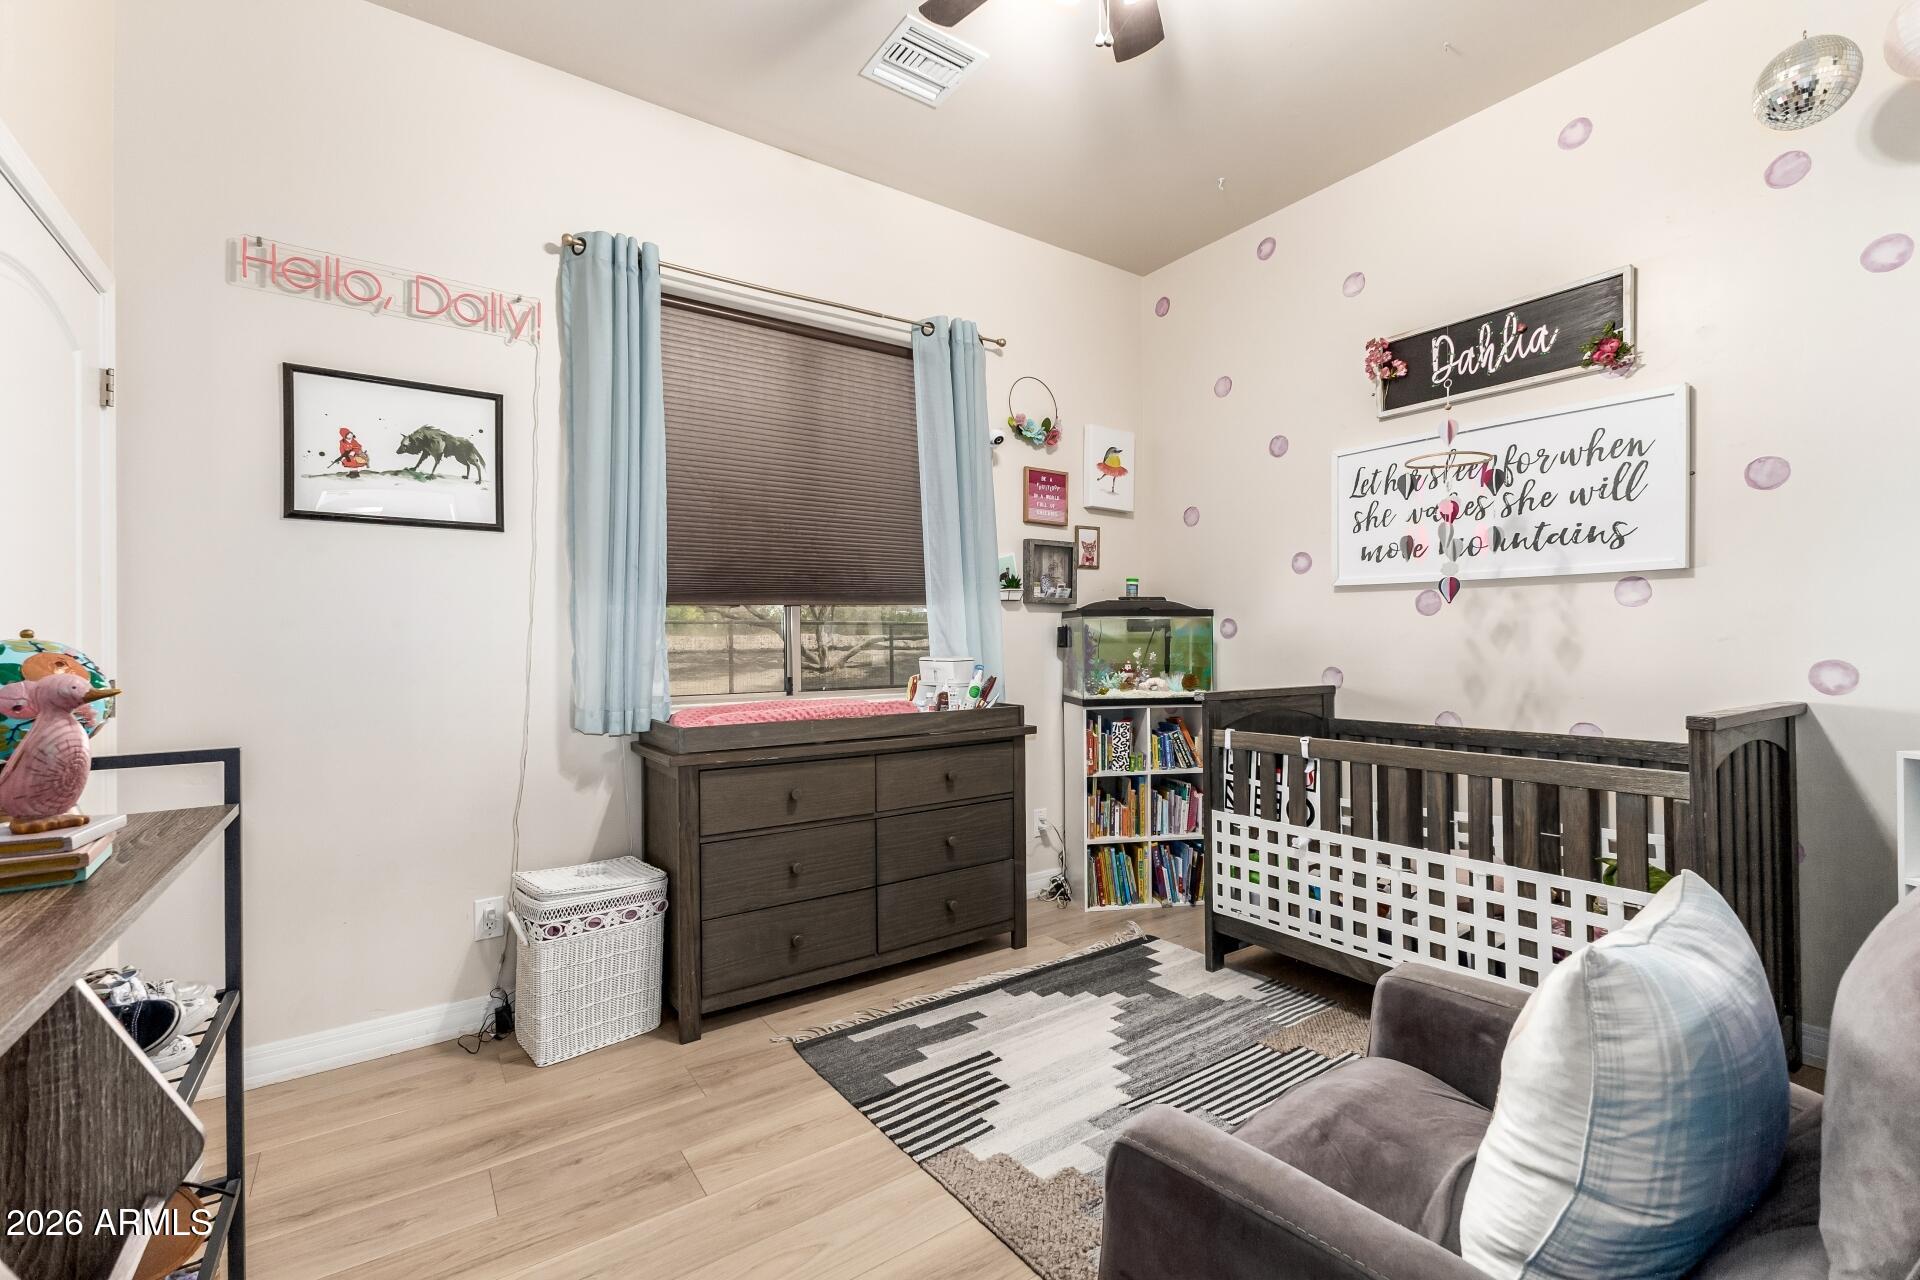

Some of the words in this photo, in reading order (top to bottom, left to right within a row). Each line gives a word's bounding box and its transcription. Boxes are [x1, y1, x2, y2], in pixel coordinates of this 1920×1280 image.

[242, 236, 393, 310] Hello,
[415, 274, 542, 343] Dolly!
[1431, 311, 1560, 385] Dahlia
[1349, 466, 1382, 499] Let
[1503, 443, 1559, 488] for
[1560, 427, 1656, 467] when
[1352, 500, 1398, 534] she
[1500, 478, 1559, 519] she
[1569, 459, 1649, 507] will
[1361, 541, 1429, 564] moe
